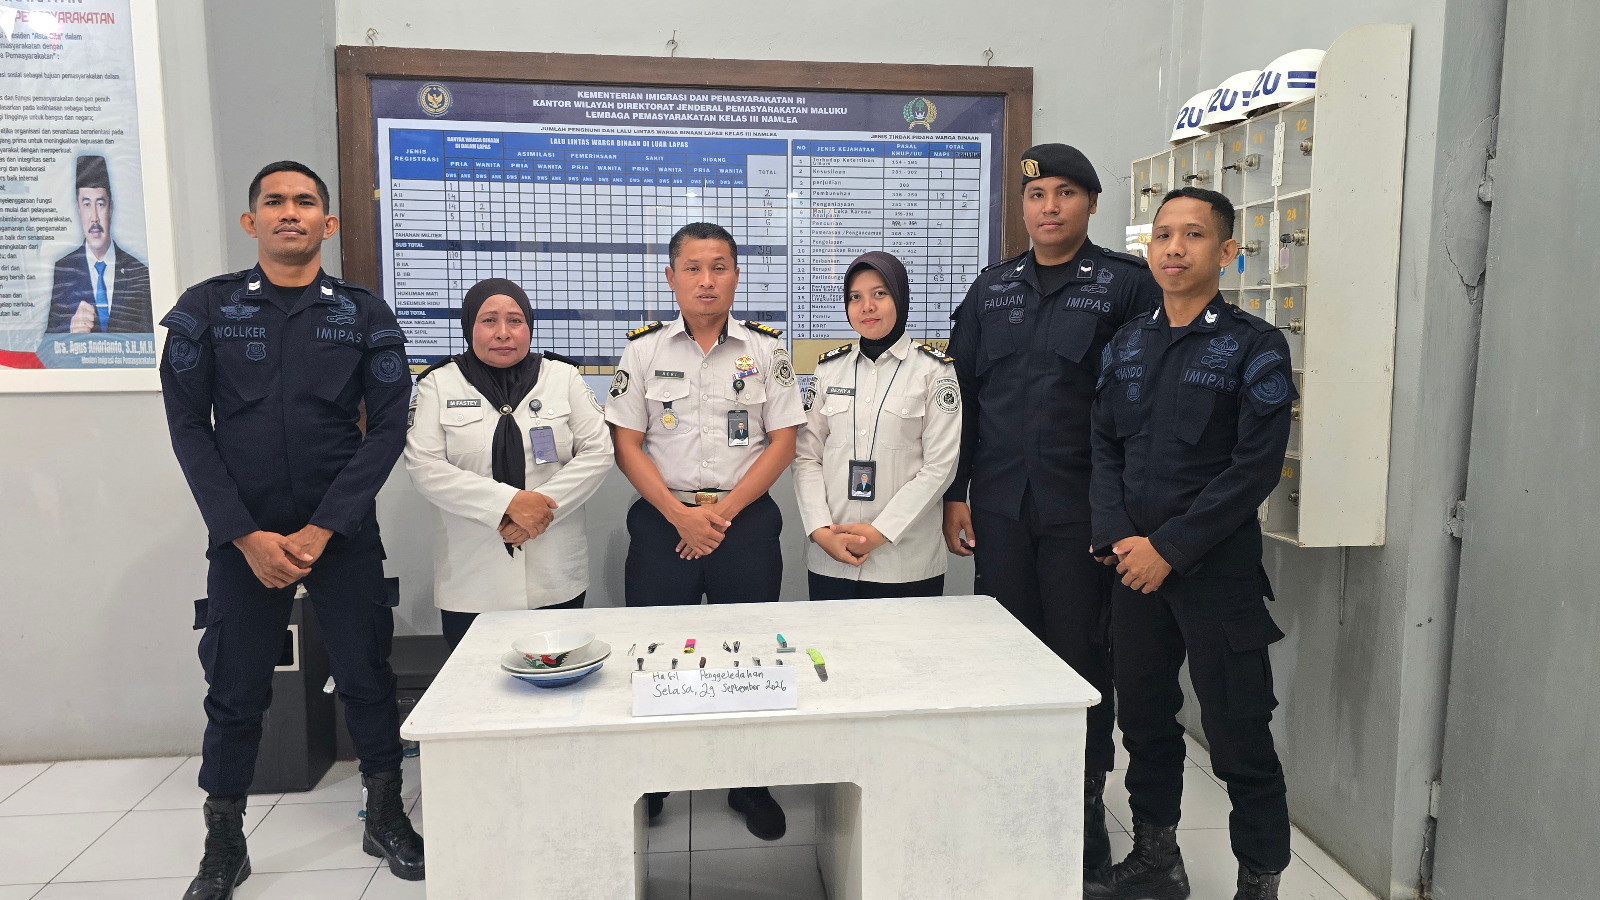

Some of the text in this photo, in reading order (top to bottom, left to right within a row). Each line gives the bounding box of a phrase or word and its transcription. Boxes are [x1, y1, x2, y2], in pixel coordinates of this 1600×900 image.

[42, 43, 63, 51] dengan
[578, 91, 643, 100] KEMENTERIAN
[646, 93, 687, 101] IMIGRASI
[690, 94, 708, 102] DAN
[711, 95, 794, 104] PEMASYARAKATAN
[1208, 88, 1238, 113] 2U
[533, 99, 848, 115] KANTOR WILAYAH DIREKTORAT JENDERAL PEMASYARAKATAN MALUKU
[586, 111, 798, 124] LEMBAGA PEMASYARAKATAN KELAS III NAMLEA
[1176, 107, 1204, 130] 2U
[1296, 118, 1307, 132] 12
[567, 138, 589, 146] LINTAS
[617, 139, 640, 147] BINAAN
[651, 140, 667, 148] LUAR
[669, 140, 689, 148] LAPAS
[1254, 132, 1263, 144] 11
[1232, 141, 1241, 152] 10
[394, 155, 439, 163] REGISTRASI
[1254, 215, 1264, 227] 23
[1286, 208, 1297, 221] 24
[984, 295, 1024, 310] FAUJAN
[1066, 297, 1111, 313] IMIPAS
[1249, 299, 1260, 310] 35
[1283, 298, 1294, 309] 36
[213, 326, 266, 339] WOLLKER
[316, 328, 363, 343] IMIPAS
[54, 340, 68, 354] Drs.
[70, 340, 87, 354] Agus
[88, 340, 124, 354] Andrianto,
[1183, 369, 1236, 392] IMIPAS
[700, 669, 763, 682] Penggeledahan
[653, 684, 697, 697] Selasa,
[721, 682, 760, 694] September
[766, 680, 786, 691] 2026
